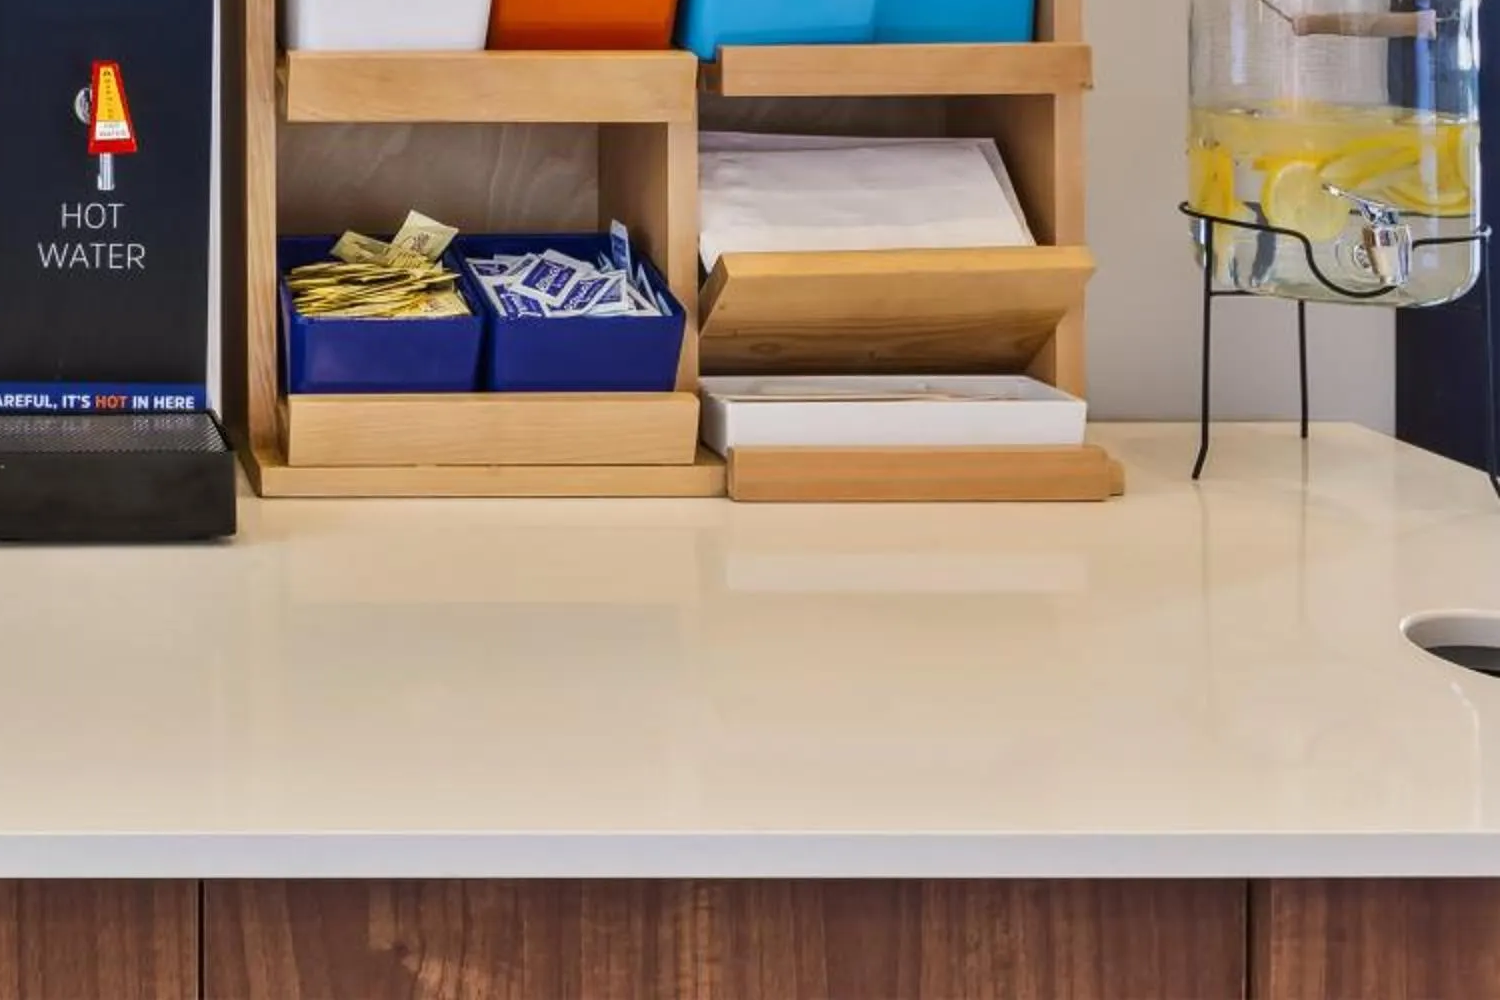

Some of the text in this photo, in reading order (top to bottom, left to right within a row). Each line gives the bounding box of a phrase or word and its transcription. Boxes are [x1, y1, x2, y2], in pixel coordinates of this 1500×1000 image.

[61, 203, 125, 229] HOT
[37, 242, 146, 269] WATER
[62, 394, 91, 409] IT'S
[95, 395, 128, 409] HOT
[132, 395, 149, 409] IN
[154, 395, 195, 409] HERE
